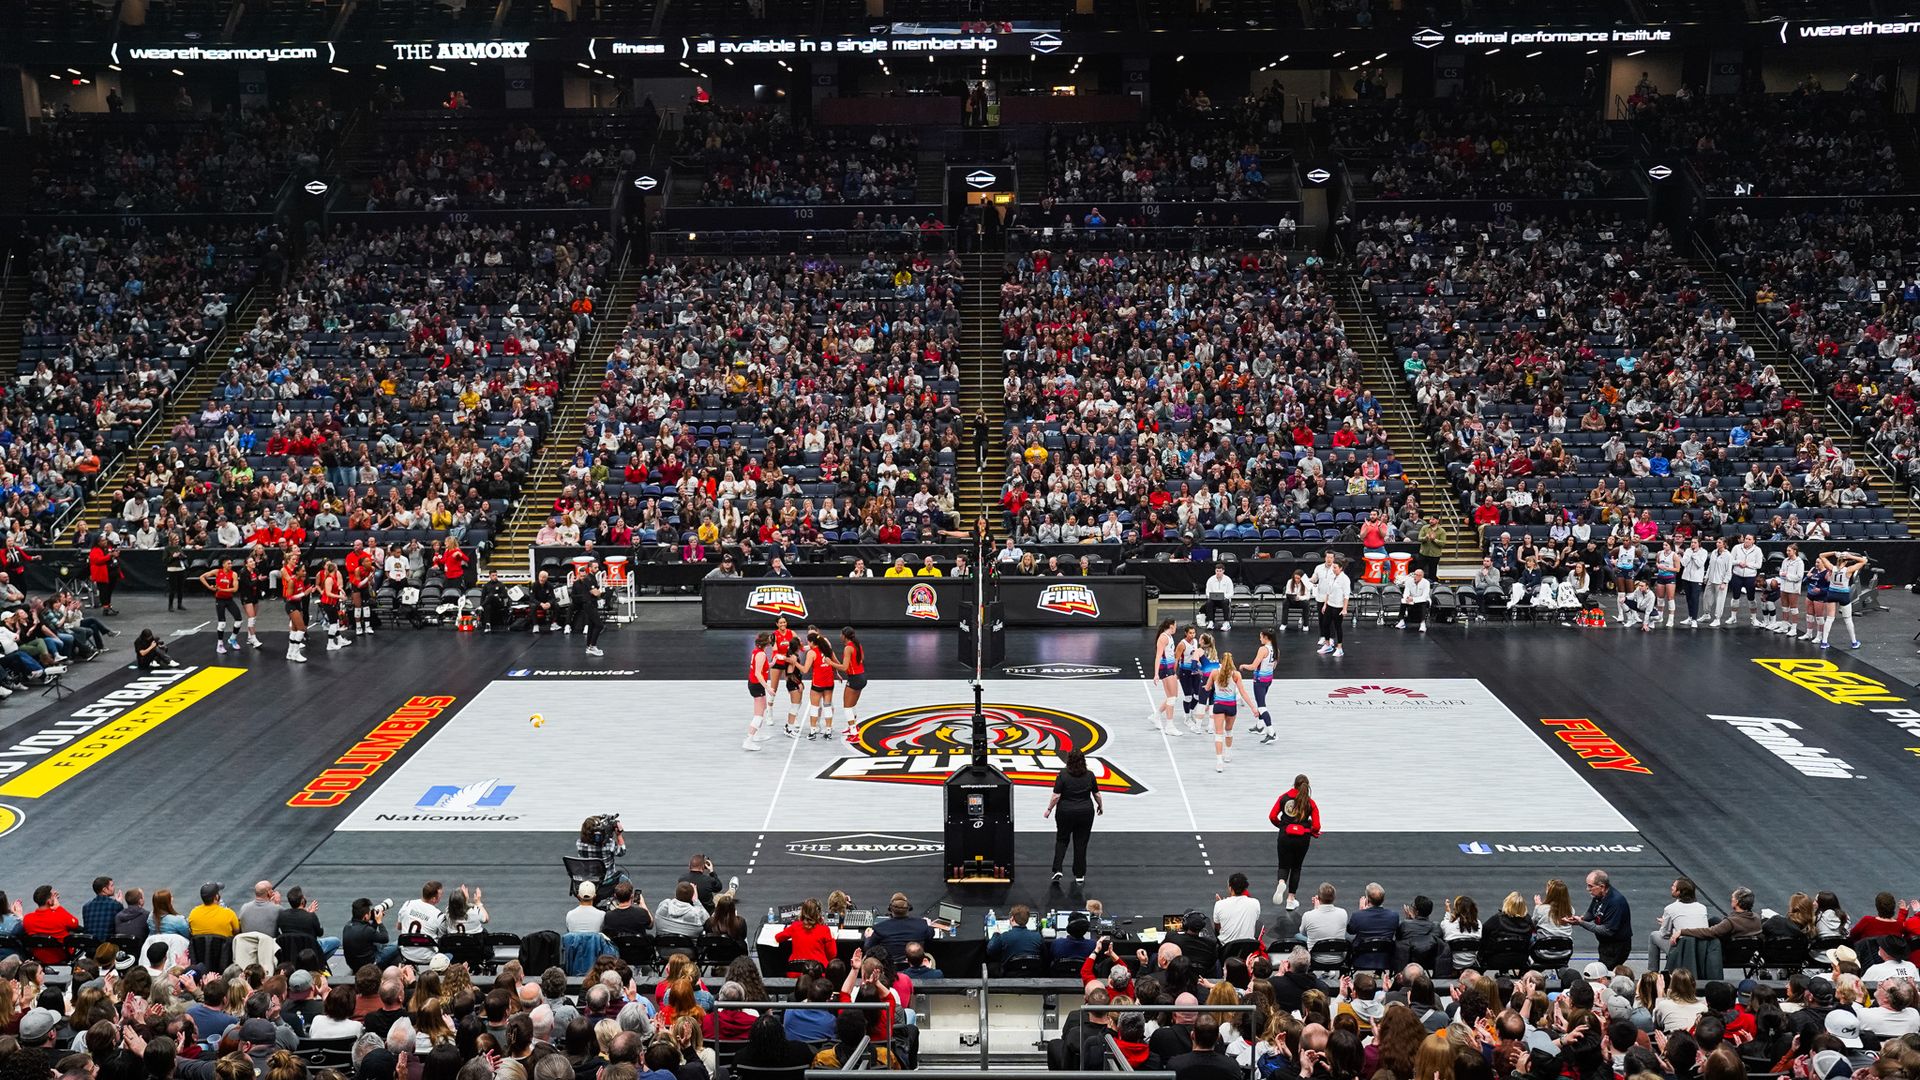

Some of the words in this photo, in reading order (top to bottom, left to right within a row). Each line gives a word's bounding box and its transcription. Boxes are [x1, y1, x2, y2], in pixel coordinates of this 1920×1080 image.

[1455, 32, 1507, 45] optimal
[1511, 31, 1608, 44] performance
[1613, 30, 1671, 41] institute
[393, 44, 432, 59] THE
[437, 42, 529, 59] ARMORY
[613, 43, 664, 53] fitness
[697, 40, 715, 53] all
[720, 40, 795, 52] available
[800, 39, 816, 51] in
[821, 42, 832, 51] a
[837, 38, 887, 53] single
[892, 37, 997, 51] membership
[130, 47, 317, 61] wearethearmory.com
[1443, 68, 1457, 78] C5
[1140, 205, 1161, 215] 104
[1492, 202, 1513, 212] 105
[449, 213, 469, 223] 102
[794, 208, 814, 219] 103
[121, 216, 142, 227] 101
[610, 565, 619, 574] G
[1371, 562, 1381, 571] G
[1397, 562, 1406, 571] G
[749, 591, 801, 607] FURY
[1040, 591, 1091, 606] FURY
[1749, 658, 1907, 706] REAL
[0, 665, 198, 758] VOLLEYBALL
[53, 689, 200, 768] FEDERATION
[286, 695, 457, 808] COLUMBUS
[887, 748, 1057, 756] COLUBUS
[1539, 718, 1654, 775] FURY
[785, 844, 832, 852] THE
[1494, 843, 1641, 853] Nationwide
[1896, 967, 1908, 976] THE
